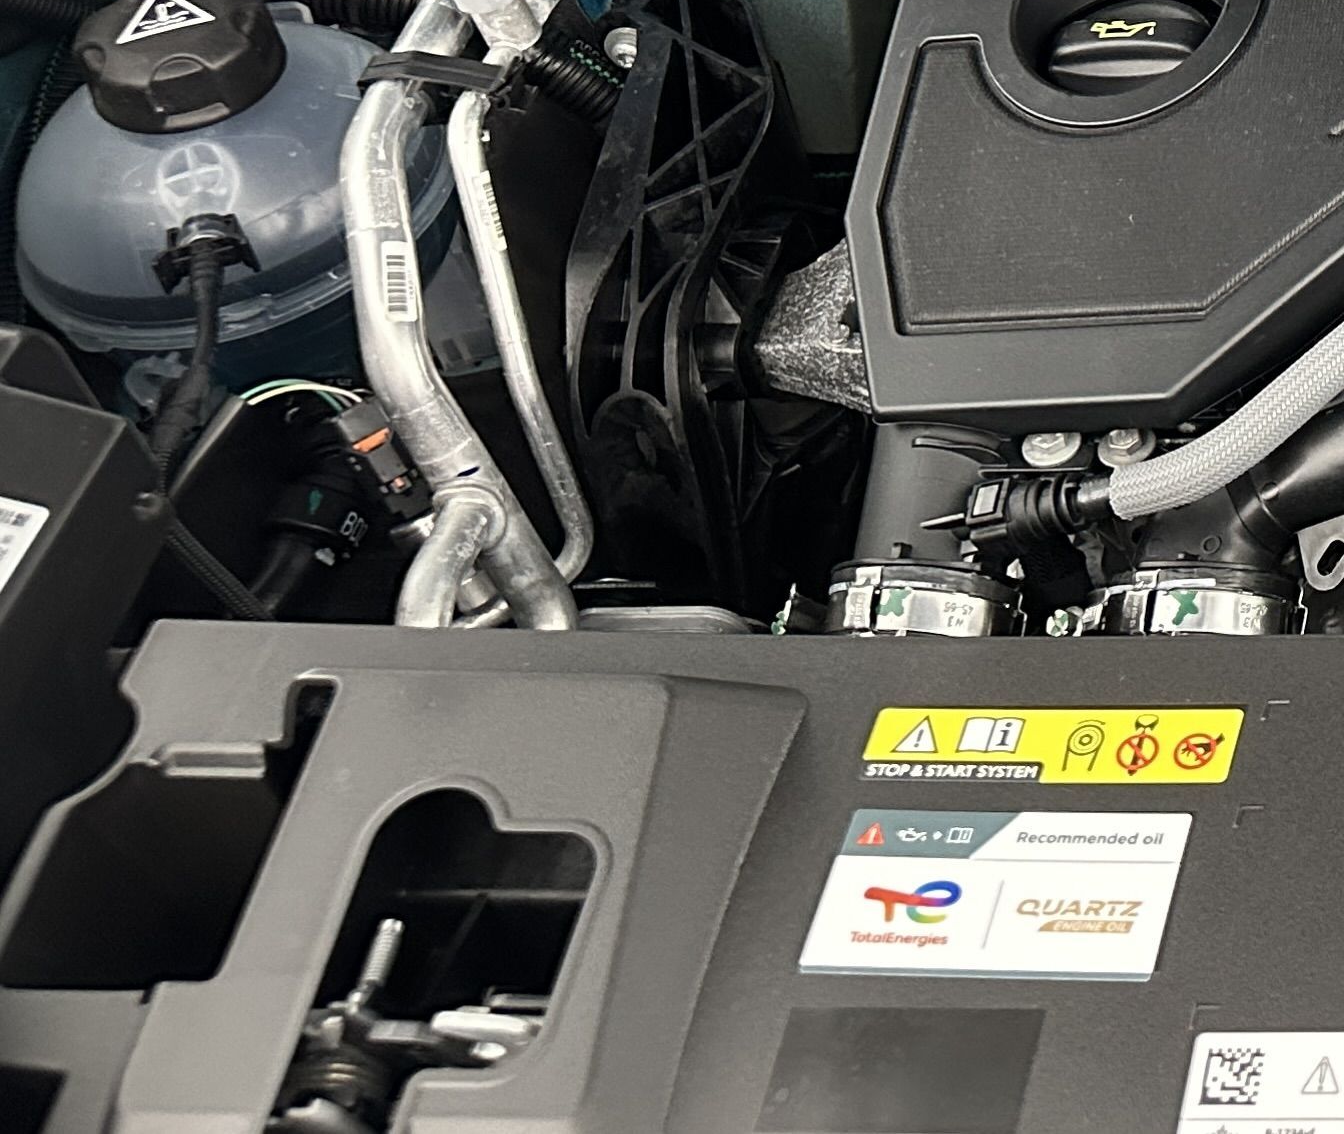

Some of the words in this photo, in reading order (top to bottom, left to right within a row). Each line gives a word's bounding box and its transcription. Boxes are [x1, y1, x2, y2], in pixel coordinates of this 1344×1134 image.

[865, 763, 911, 777] STOP
[909, 764, 923, 777] &
[924, 764, 977, 778] START
[976, 765, 1039, 778] SYSTEM
[1016, 831, 1139, 845] Recommended
[1142, 832, 1165, 845] oil
[1015, 898, 1144, 917] QUARTZ
[1052, 920, 1105, 932] ENGINE
[1105, 920, 1129, 933] OIL
[850, 930, 949, 948] TotalEnergies
